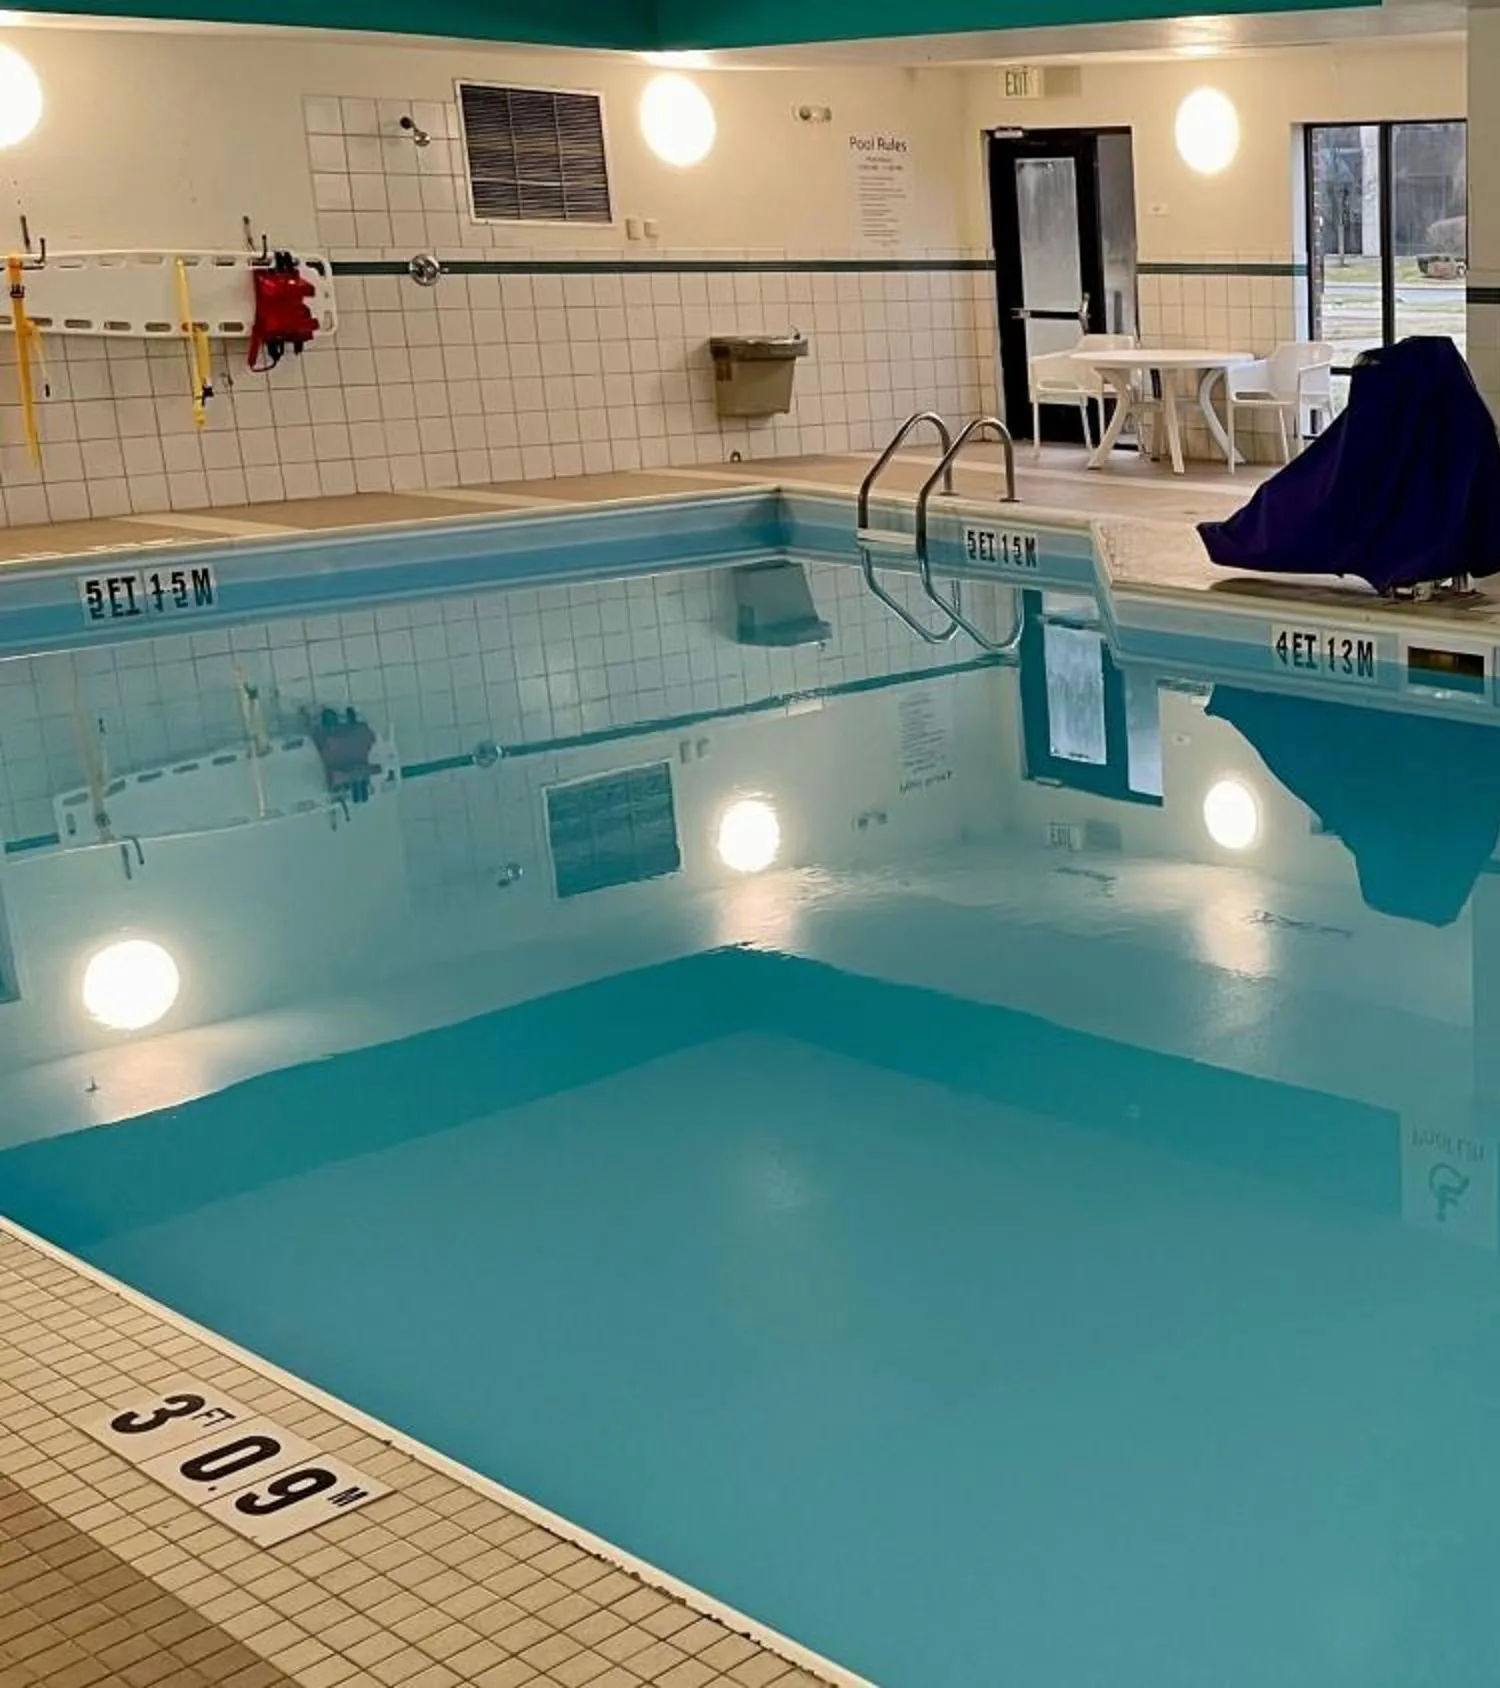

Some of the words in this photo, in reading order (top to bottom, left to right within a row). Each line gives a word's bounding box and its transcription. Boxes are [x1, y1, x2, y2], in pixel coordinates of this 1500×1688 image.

[1005, 71, 1028, 97] EXIT
[849, 136, 875, 151] Pool
[877, 136, 908, 153] Rules
